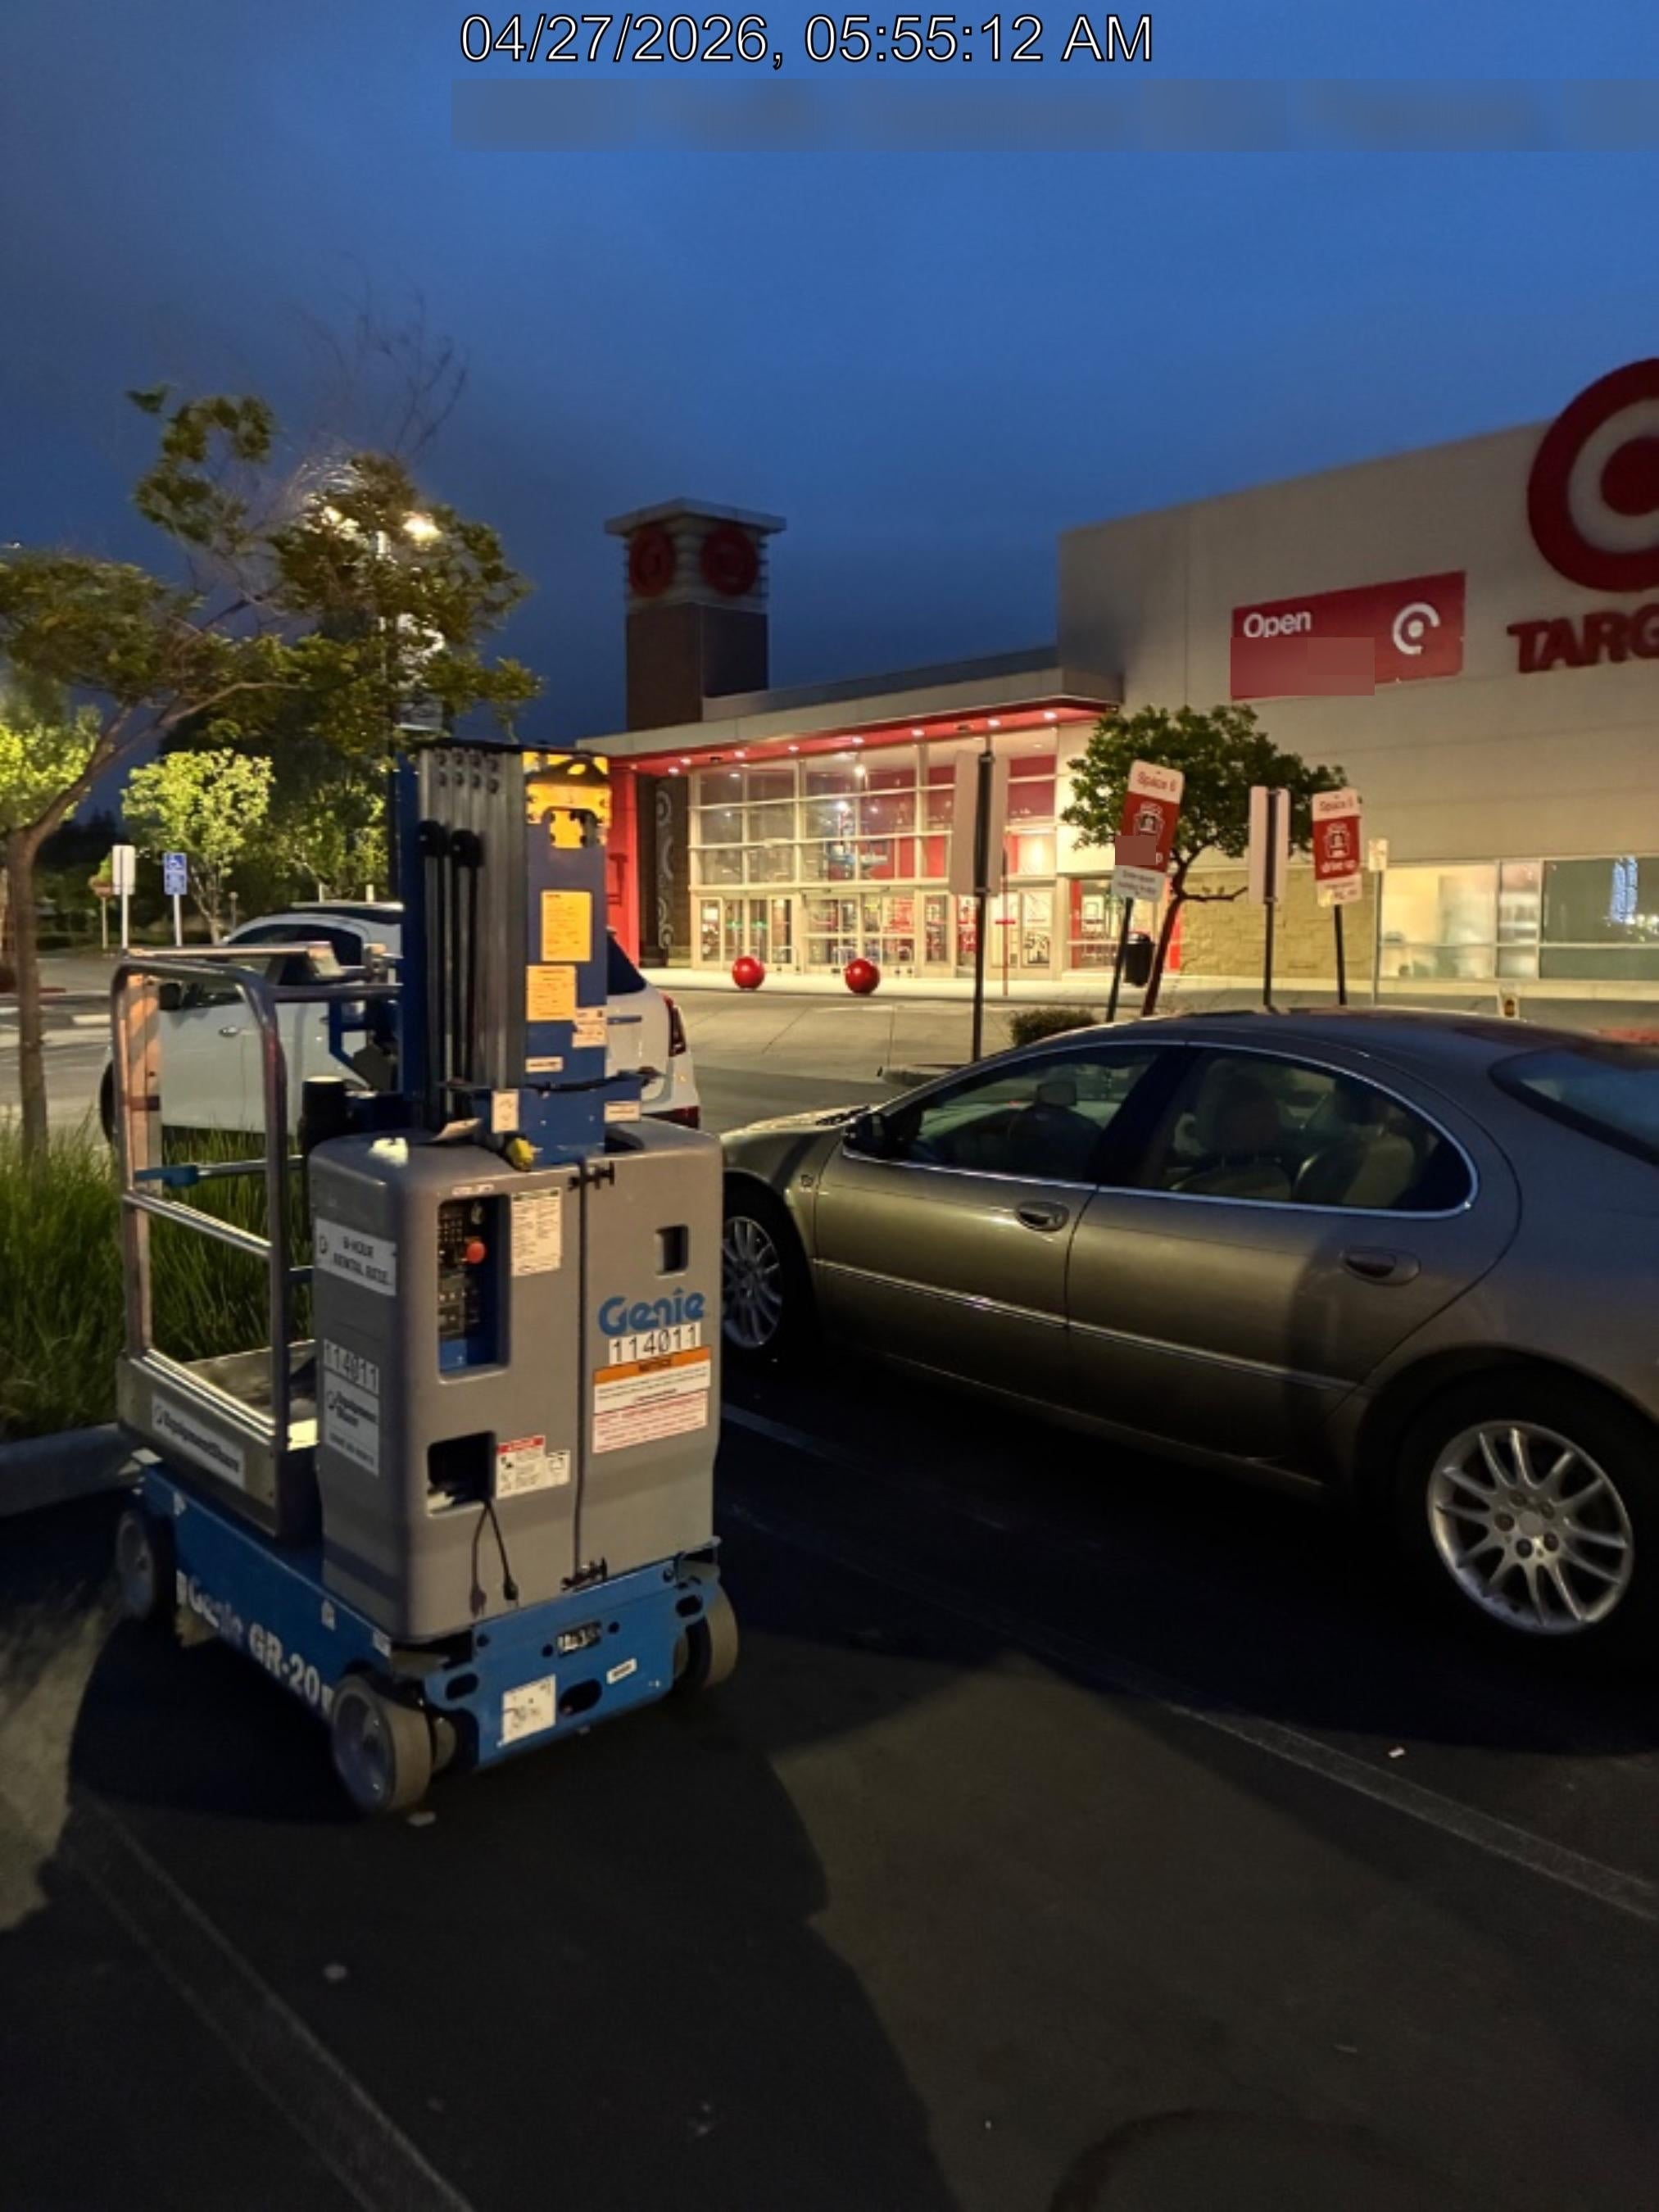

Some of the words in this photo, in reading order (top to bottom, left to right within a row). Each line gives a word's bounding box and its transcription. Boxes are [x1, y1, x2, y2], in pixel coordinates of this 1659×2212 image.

[1243, 610, 1312, 637] Open
[598, 1288, 705, 1337] Genie
[614, 1325, 696, 1362] 114011
